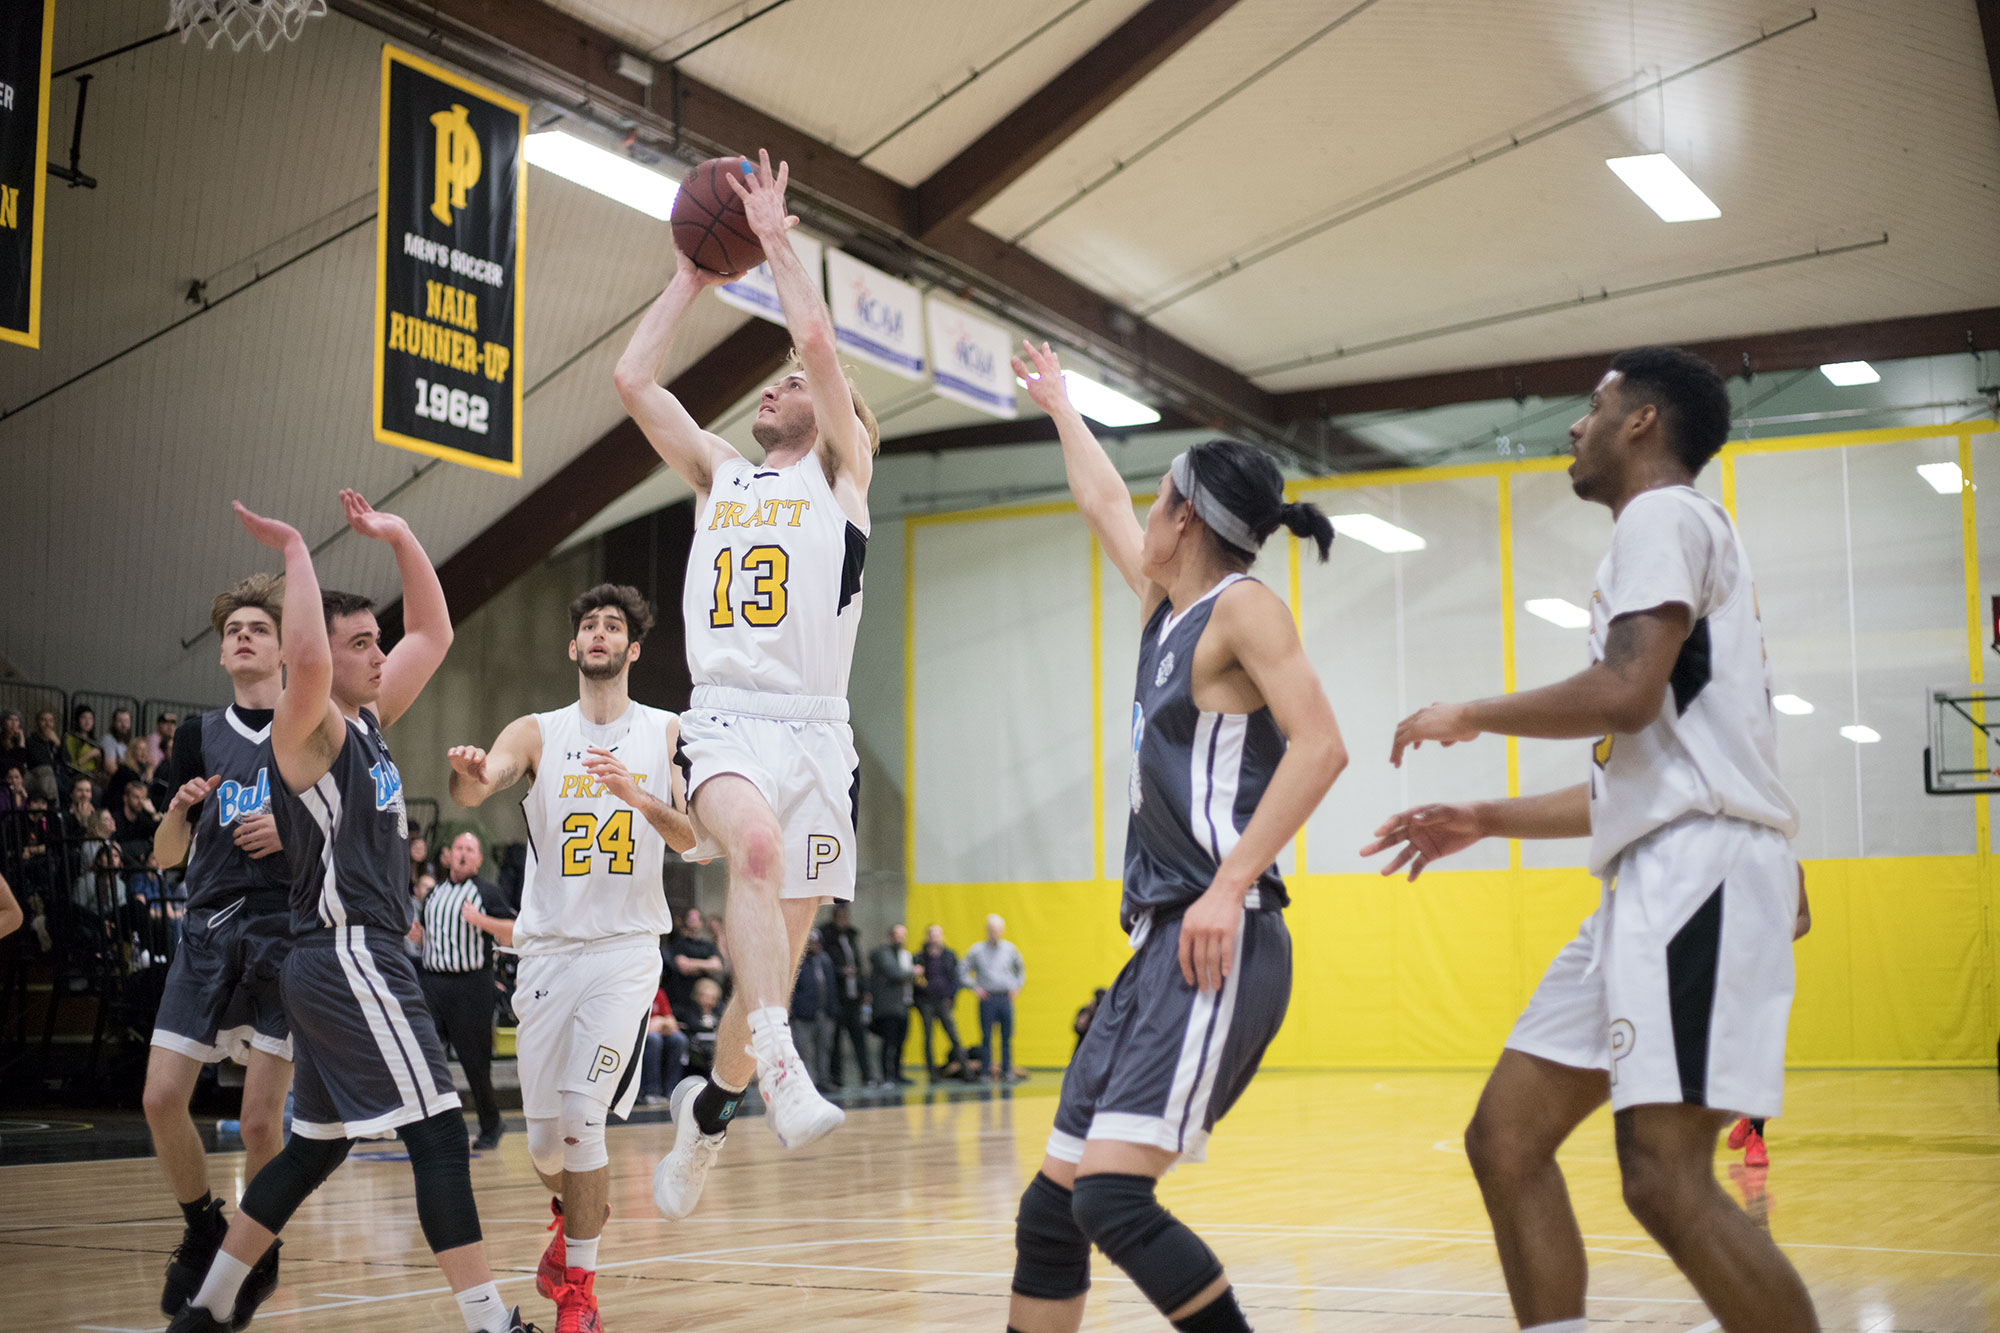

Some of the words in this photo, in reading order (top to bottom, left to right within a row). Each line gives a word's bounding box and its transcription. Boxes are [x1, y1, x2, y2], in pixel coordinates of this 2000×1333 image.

[404, 232, 449, 268] MEN'S
[450, 250, 504, 288] SOCCER
[426, 279, 478, 333] NAIA
[388, 311, 510, 384] RUNNER-UP
[415, 377, 489, 435] 1962
[708, 499, 811, 531] PRATT
[710, 544, 790, 629] 13
[562, 809, 635, 877] 24
[807, 834, 841, 880] P
[587, 1045, 621, 1083] P
[1608, 1018, 1636, 1087] P
